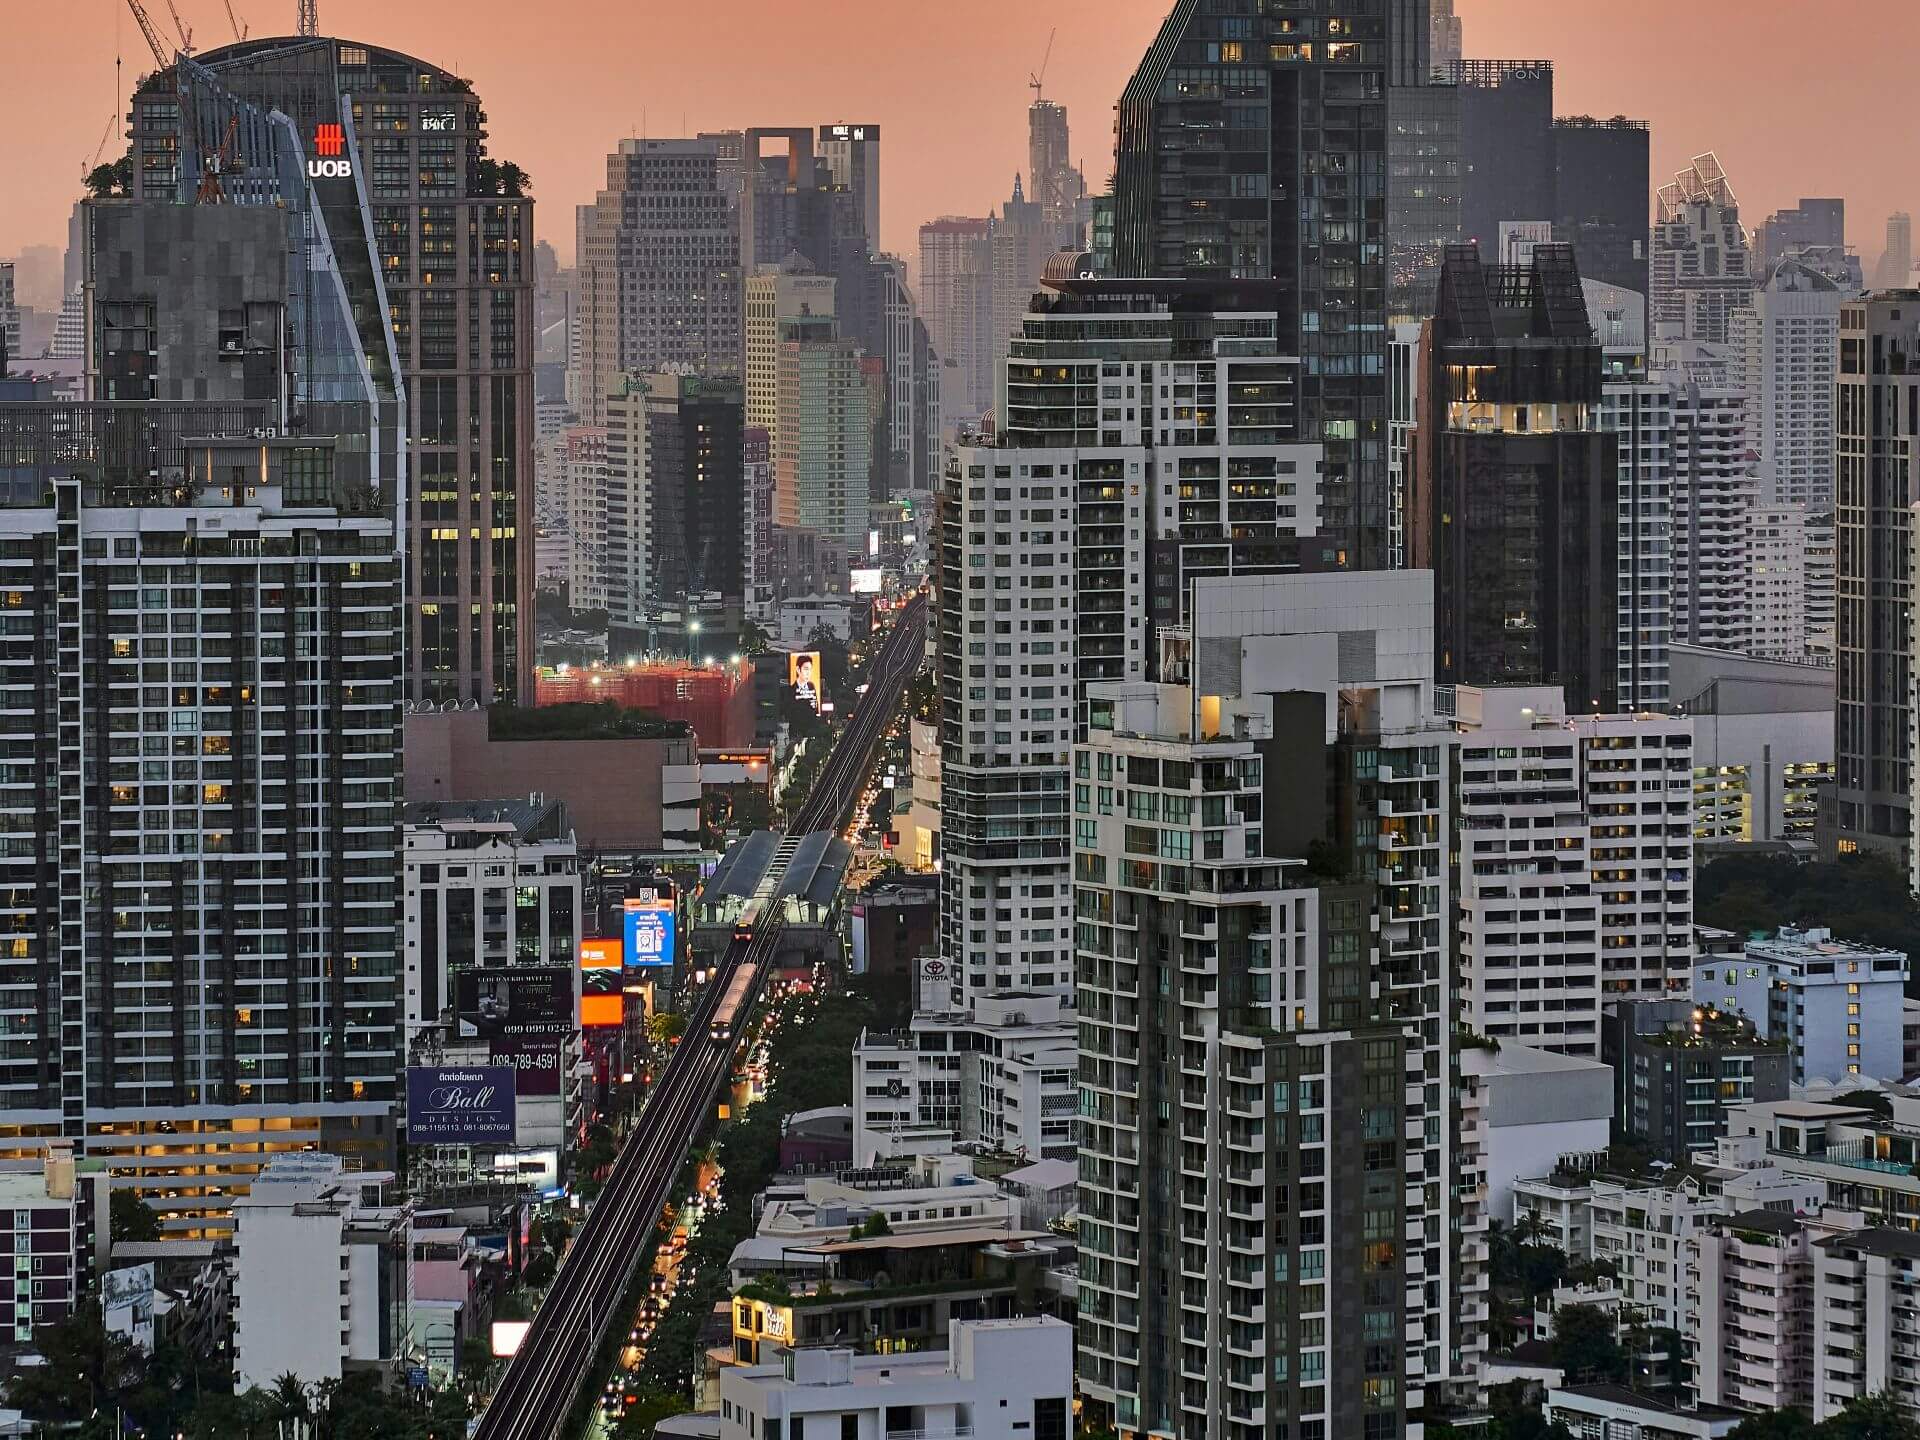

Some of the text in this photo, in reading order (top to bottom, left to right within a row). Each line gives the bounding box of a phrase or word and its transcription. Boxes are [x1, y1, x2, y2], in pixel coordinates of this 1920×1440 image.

[308, 160, 351, 177] UOB
[547, 1024, 571, 1033] 0242
[429, 1086, 495, 1109] Ball
